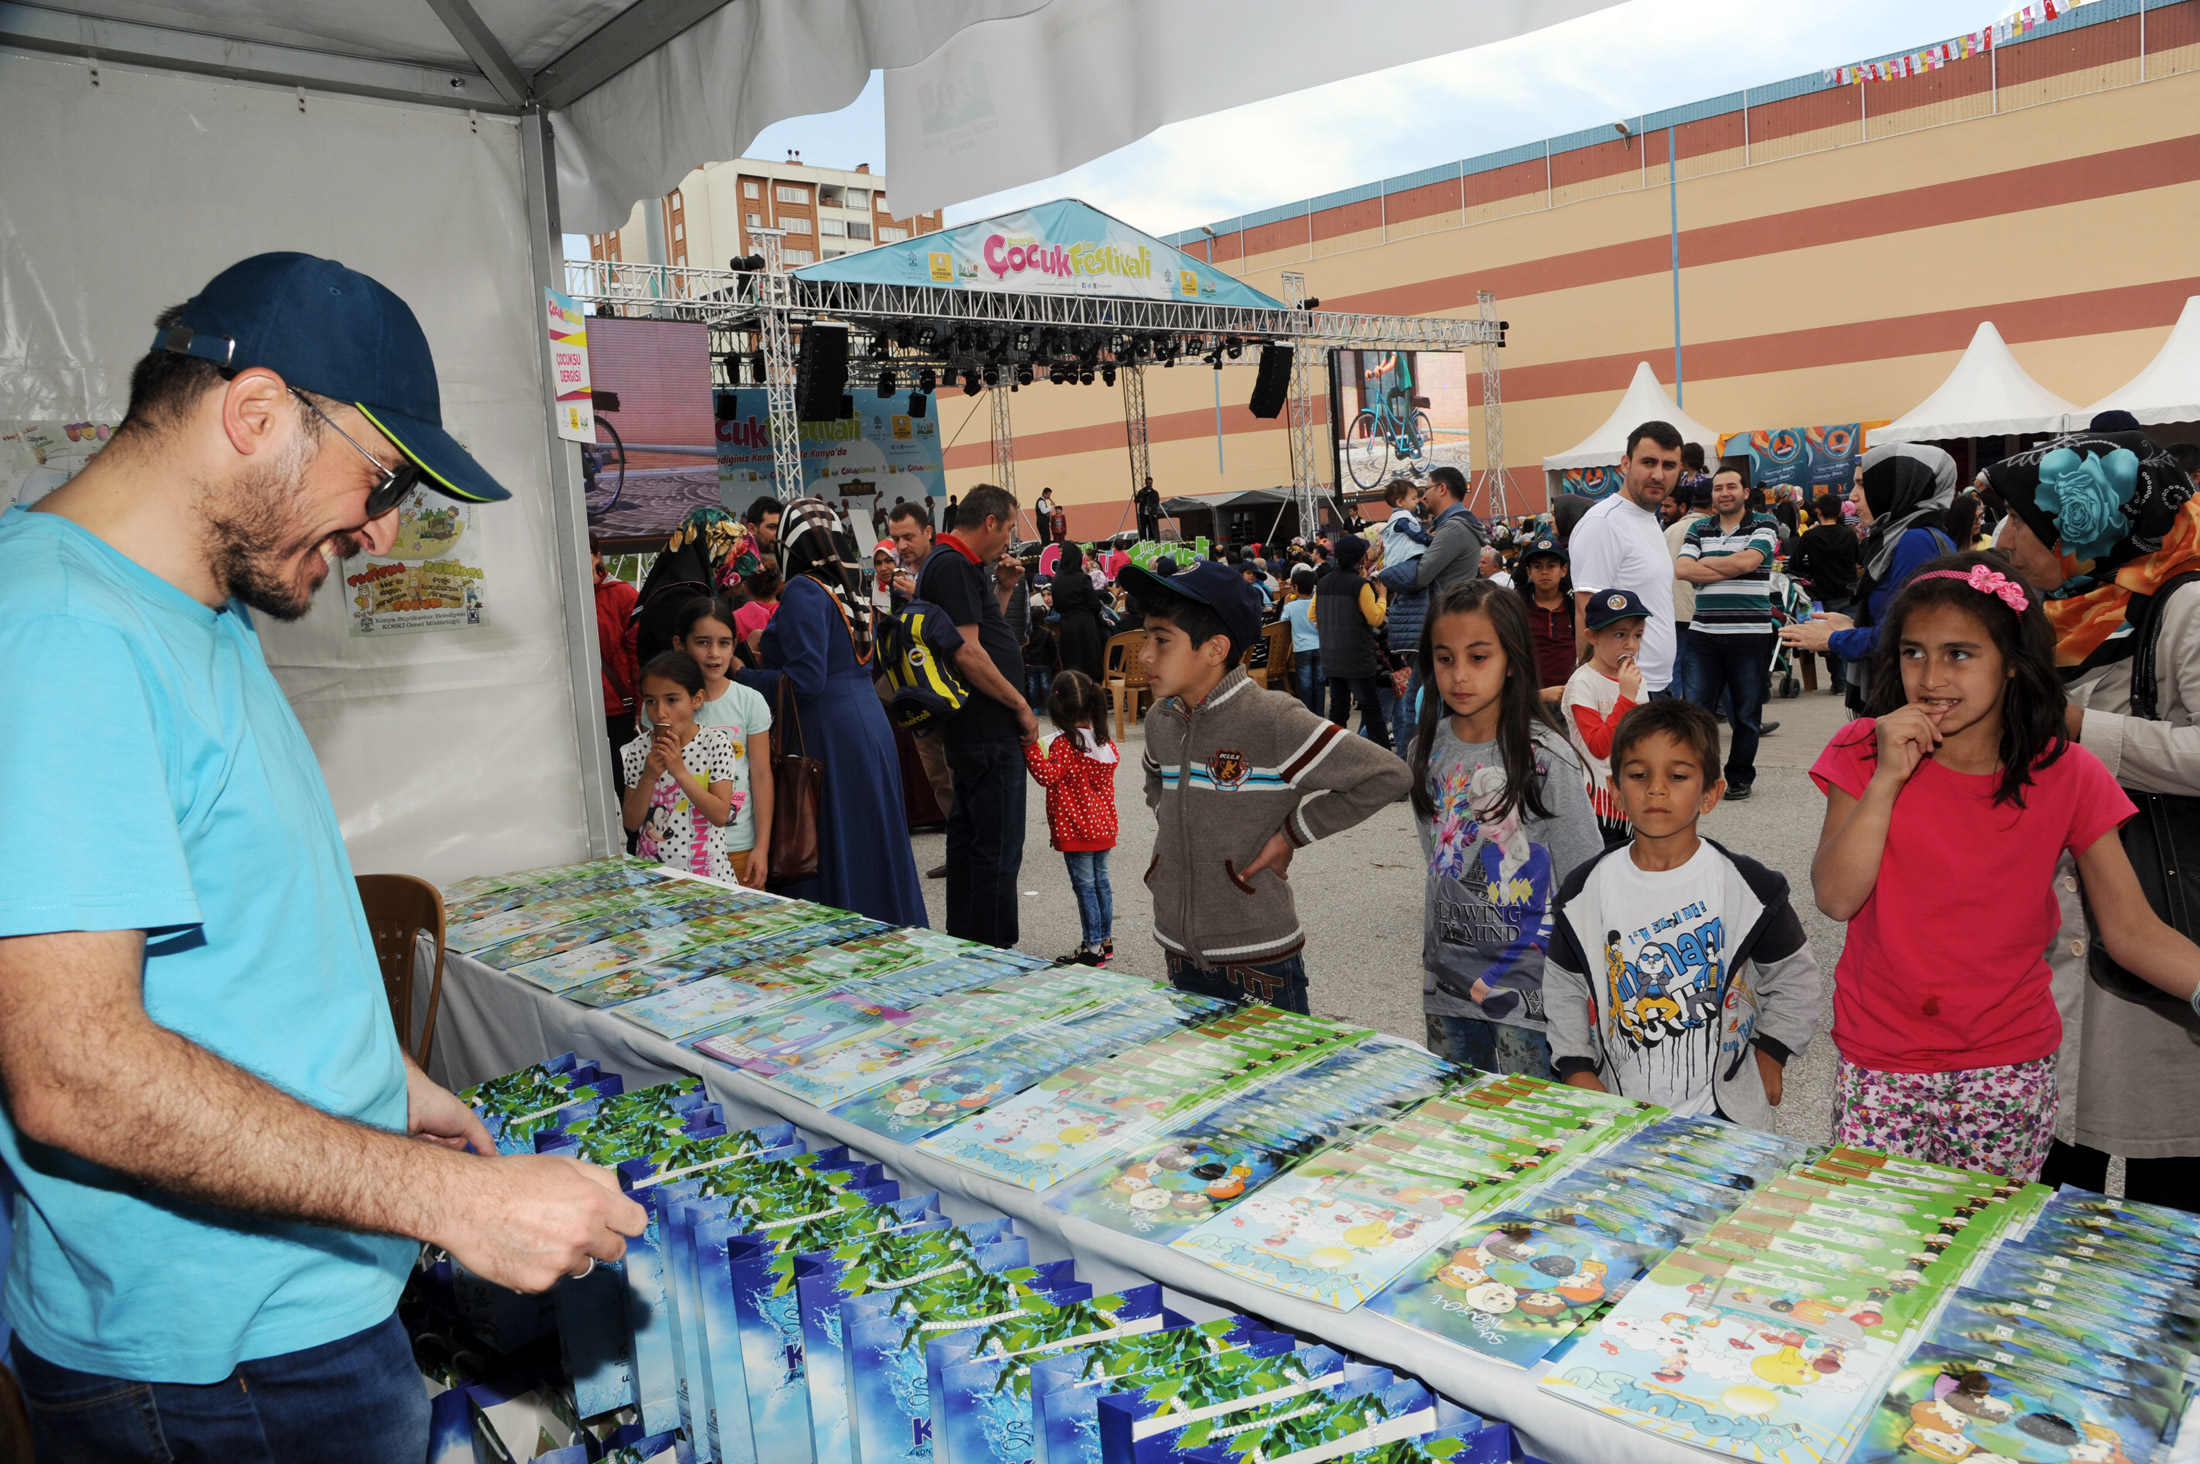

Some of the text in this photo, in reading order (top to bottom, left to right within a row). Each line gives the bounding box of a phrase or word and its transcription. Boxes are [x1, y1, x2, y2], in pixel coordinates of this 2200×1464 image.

[984, 234, 1152, 280] Çocuk Festivali
[556, 353, 581, 367] ÇOCUKSU
[559, 367, 582, 383] DERGİSİ
[375, 611, 466, 625] Konya Büyükşehir Belediyesi
[382, 618, 461, 630] KOSKİ Genel Müdürlüğü
[1462, 922, 1520, 942] MIND
